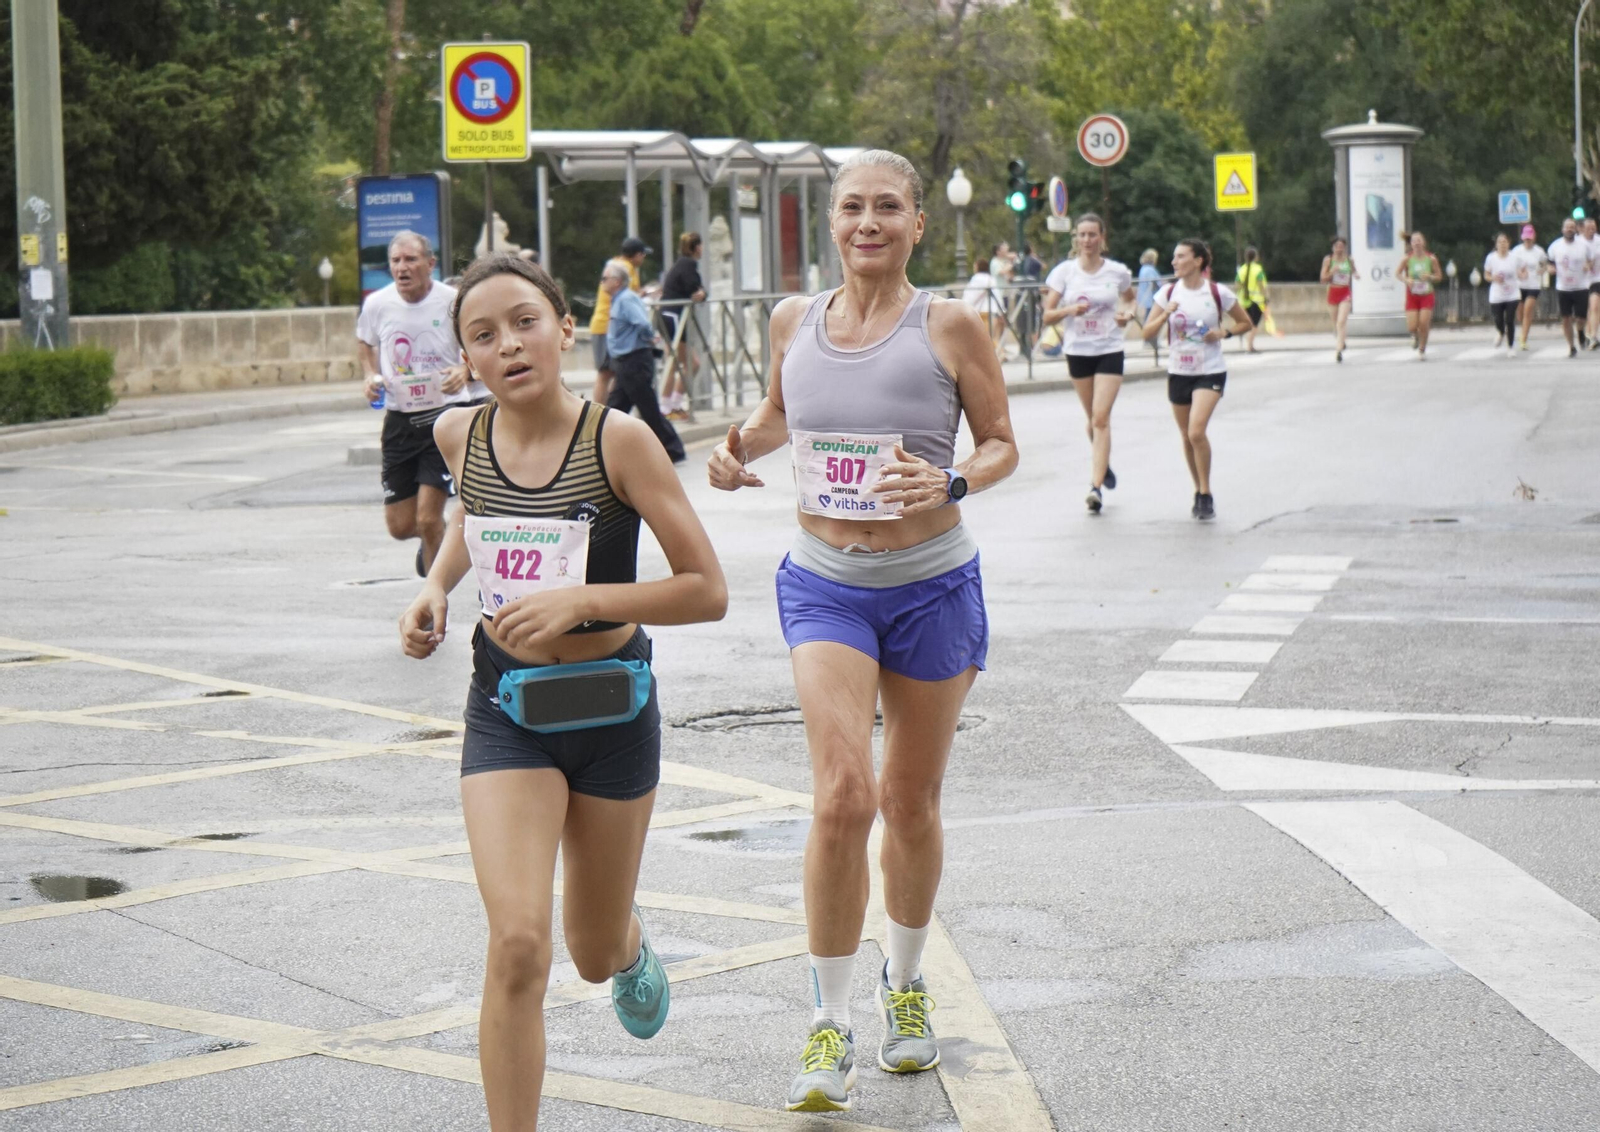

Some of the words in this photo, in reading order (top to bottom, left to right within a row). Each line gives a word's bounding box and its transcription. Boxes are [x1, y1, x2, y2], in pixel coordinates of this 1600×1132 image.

[480, 82, 490, 95] P
[472, 100, 498, 109] BUS
[458, 130, 489, 141] SOLO
[491, 130, 515, 141] BUS
[1090, 133, 1116, 148] 30
[450, 145, 523, 154] METROPOLITANO
[408, 384, 426, 397] 767
[812, 441, 879, 455] COVIRAN
[826, 456, 866, 485] 507
[831, 486, 859, 495] CAMPEONA
[580, 502, 600, 514] JOVEN
[834, 498, 876, 511] vithas
[522, 524, 562, 532] Fundación
[481, 530, 561, 544] COVIRAN
[495, 549, 543, 580] 422
